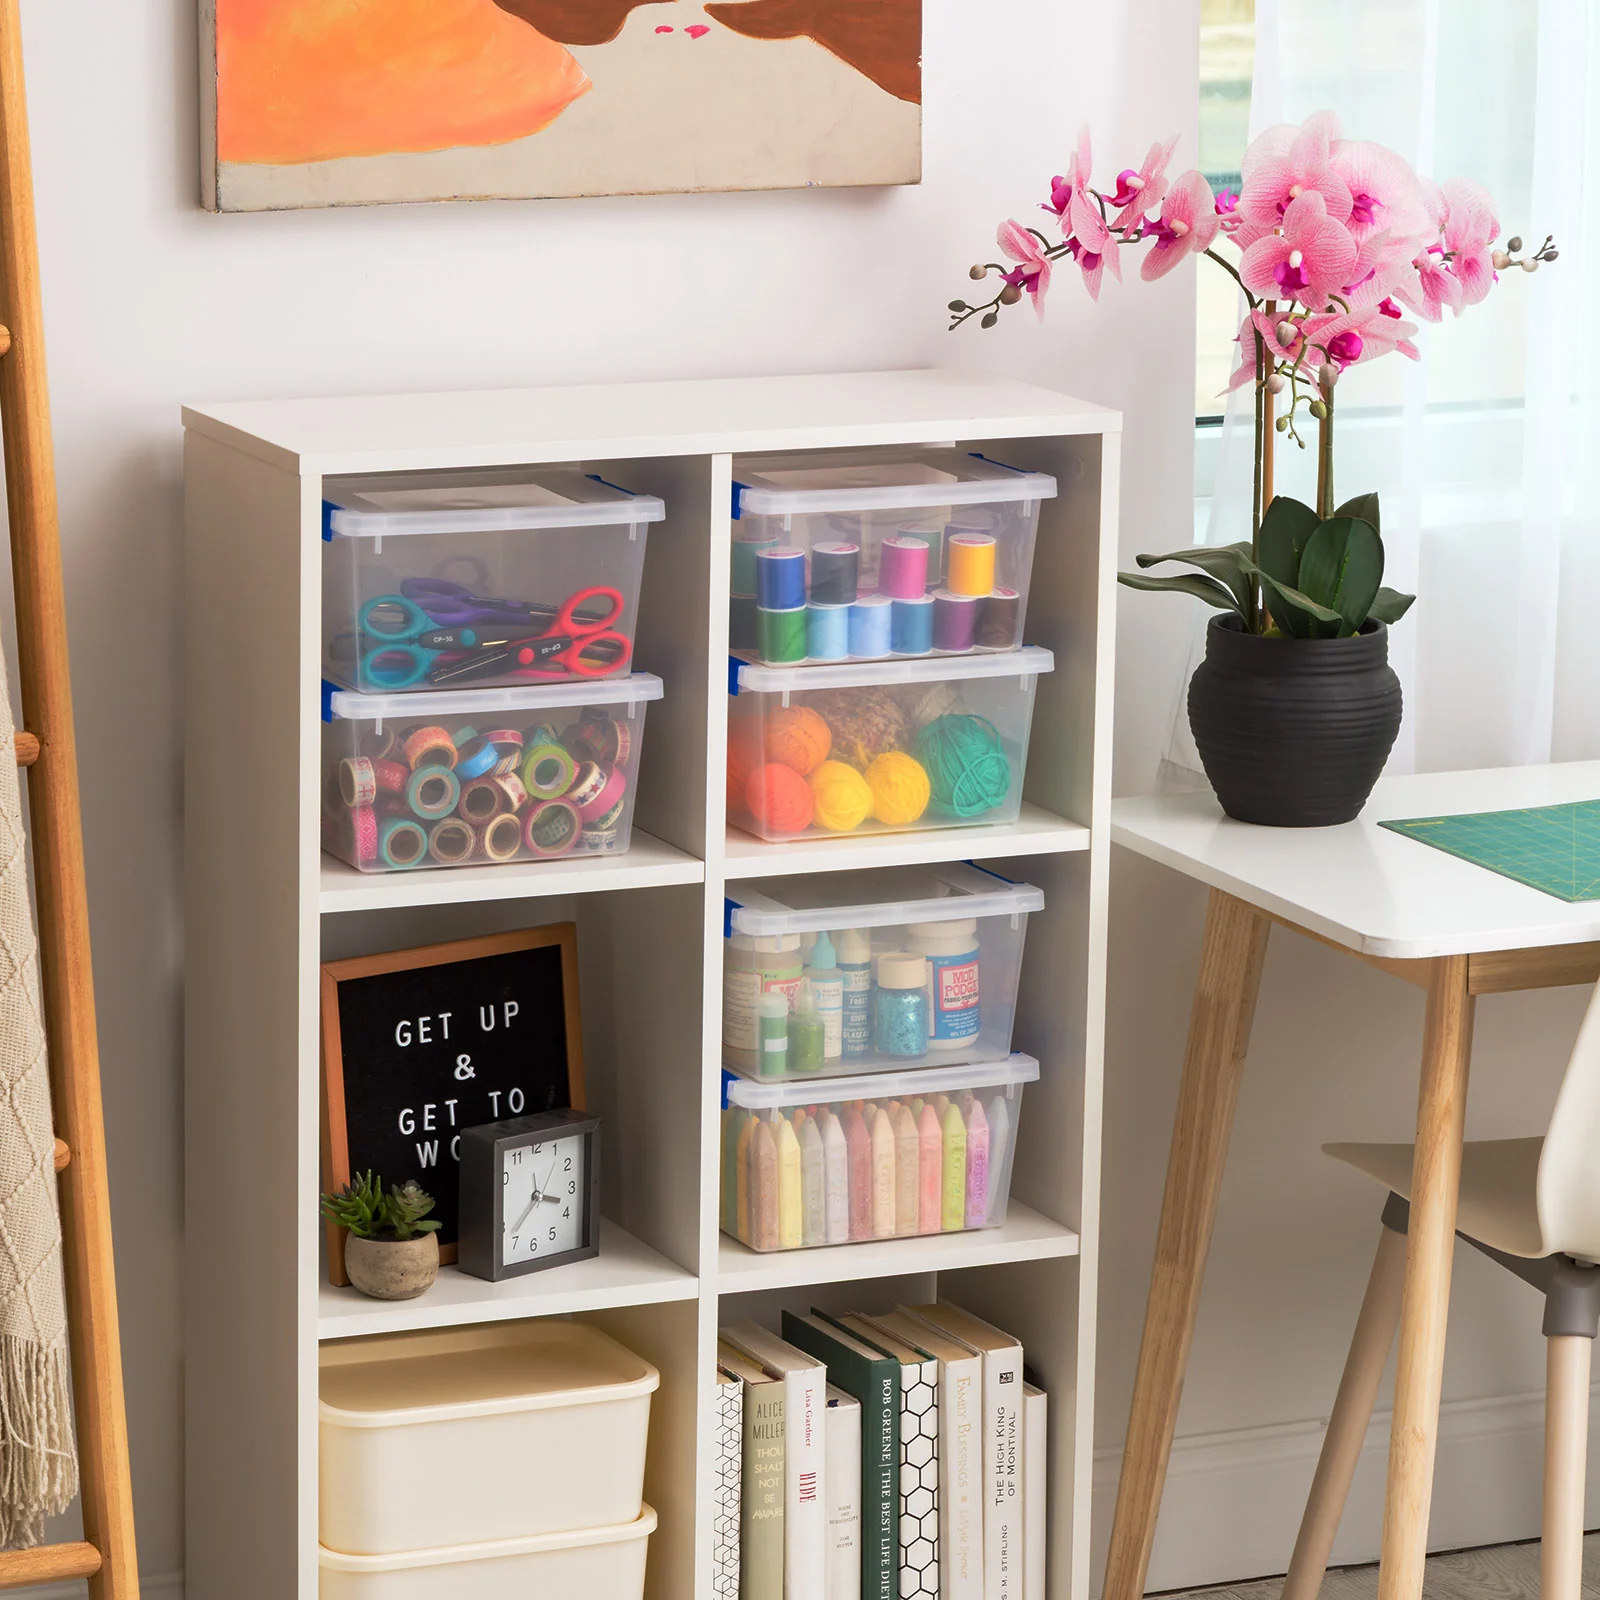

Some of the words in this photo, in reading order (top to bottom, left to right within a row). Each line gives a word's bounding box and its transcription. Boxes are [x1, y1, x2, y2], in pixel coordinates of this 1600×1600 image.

[952, 968, 974, 984] MOD
[395, 1012, 452, 1047] GET
[480, 1000, 519, 1032] UP
[453, 1053, 476, 1081] &
[398, 1099, 458, 1135] GET
[488, 1087, 525, 1118] TO
[415, 1135, 461, 1169] WO
[511, 1150, 522, 1165] 11
[531, 1143, 542, 1155] 12
[552, 1142, 558, 1156] 1
[563, 1157, 572, 1172] 2
[568, 1180, 576, 1195] 3
[562, 1206, 570, 1219] 4
[548, 1226, 557, 1241] 5
[511, 1235, 519, 1250] 7
[529, 1237, 538, 1252] 6
[882, 1378, 892, 1405] BOB
[756, 1400, 783, 1419] ALICE
[805, 1410, 813, 1447] Gardner
[996, 1406, 1006, 1438] KING
[881, 1409, 893, 1462] GREENE
[1007, 1412, 1016, 1476] MONTIVAL
[756, 1446, 784, 1458] THOU
[996, 1443, 1005, 1475] HIGH
[754, 1461, 784, 1474] SHALT
[758, 1477, 780, 1489] NOT
[799, 1471, 817, 1503] HIDE
[881, 1469, 891, 1499] THE
[1007, 1481, 1016, 1497] OF
[764, 1493, 776, 1504] BE
[995, 1479, 1005, 1506] THE
[752, 1506, 784, 1520] AWARE
[881, 1501, 891, 1535] BEST
[881, 1537, 890, 1567] LIFE
[880, 1570, 890, 1600] DIET
[1001, 1575, 1008, 1588] M.
